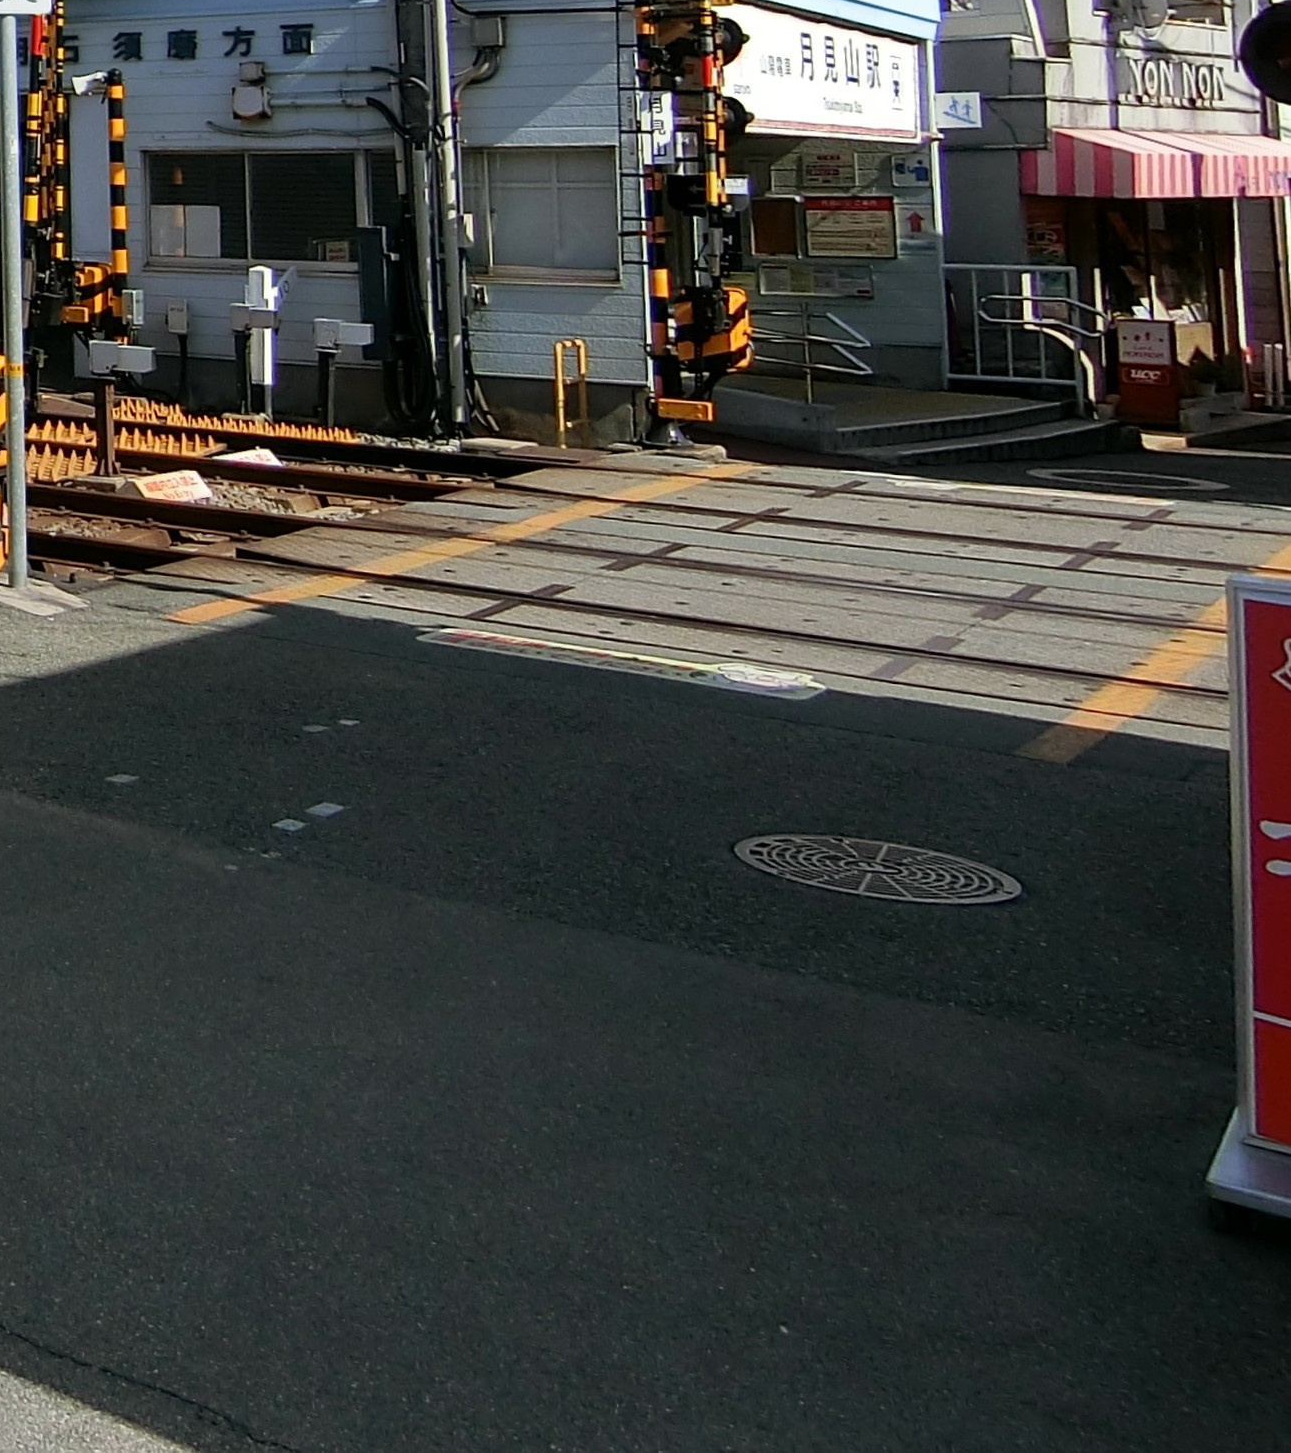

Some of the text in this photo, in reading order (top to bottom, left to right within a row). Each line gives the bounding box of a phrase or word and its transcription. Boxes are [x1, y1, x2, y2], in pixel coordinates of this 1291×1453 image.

[799, 31, 882, 89] 月見山駅
[1182, 62, 1225, 101] NON
[1130, 369, 1162, 379] UCC
